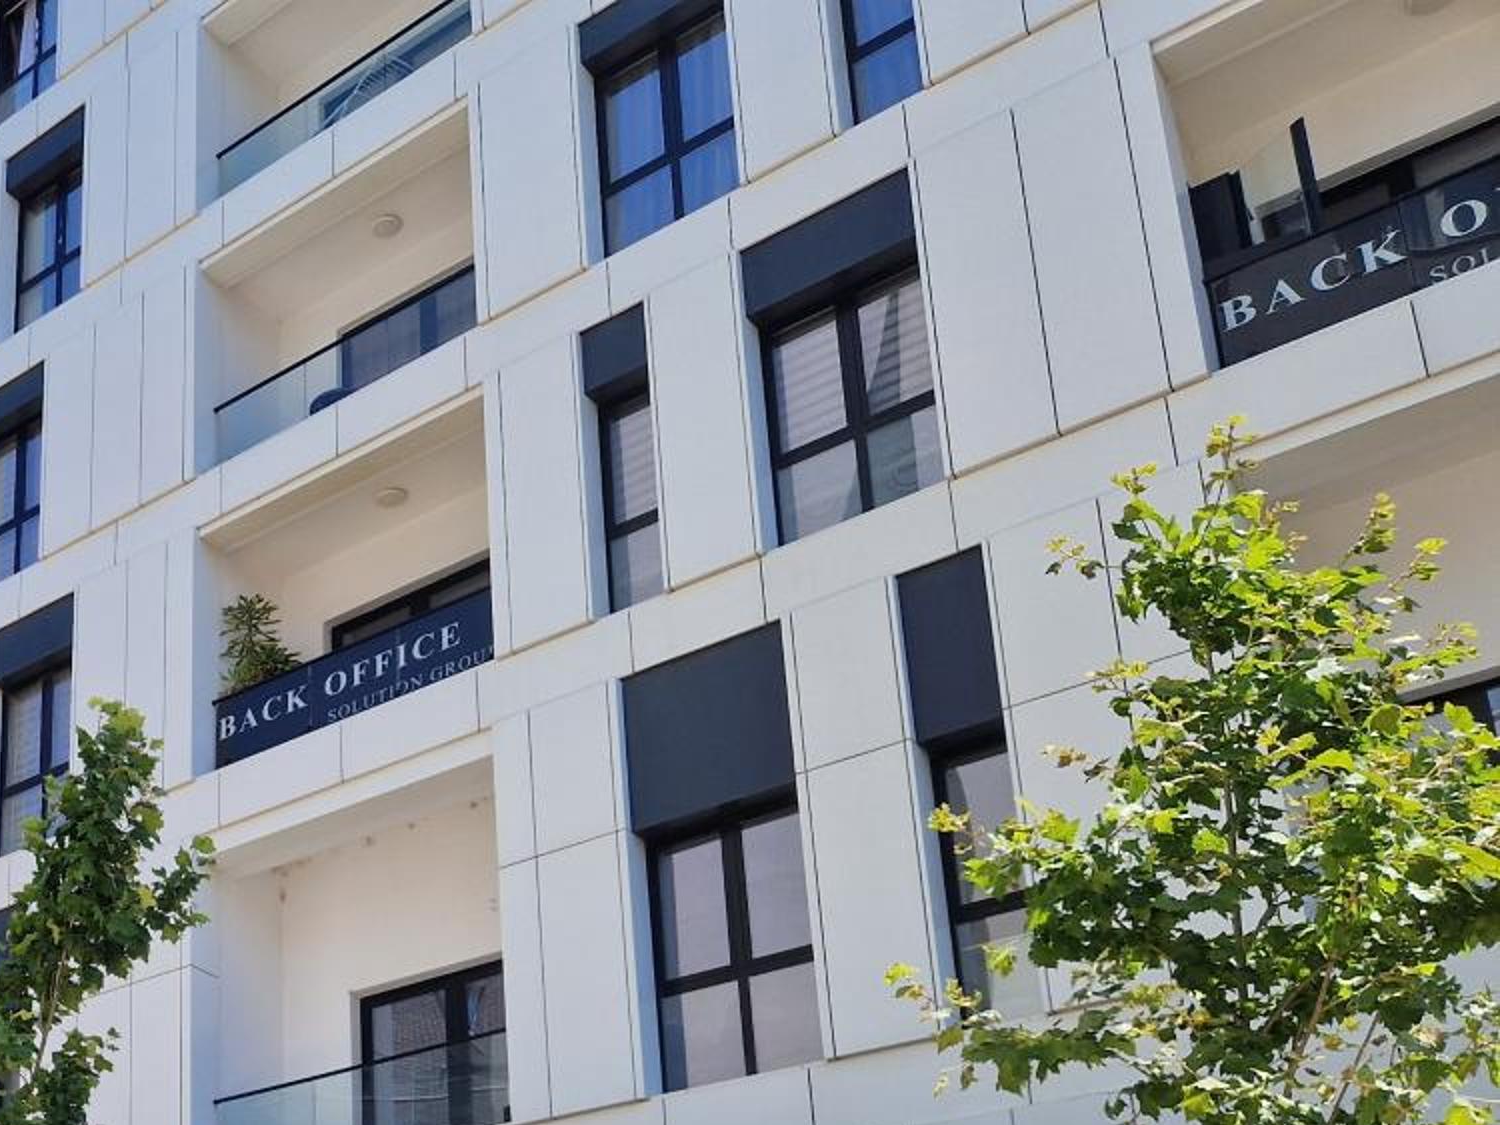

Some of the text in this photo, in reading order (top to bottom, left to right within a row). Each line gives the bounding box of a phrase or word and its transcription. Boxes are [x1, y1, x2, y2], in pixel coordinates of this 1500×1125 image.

[1219, 186, 1500, 333] BACK O
[217, 621, 461, 741] BACK OFFICE
[326, 674, 424, 722] SOLUTION
